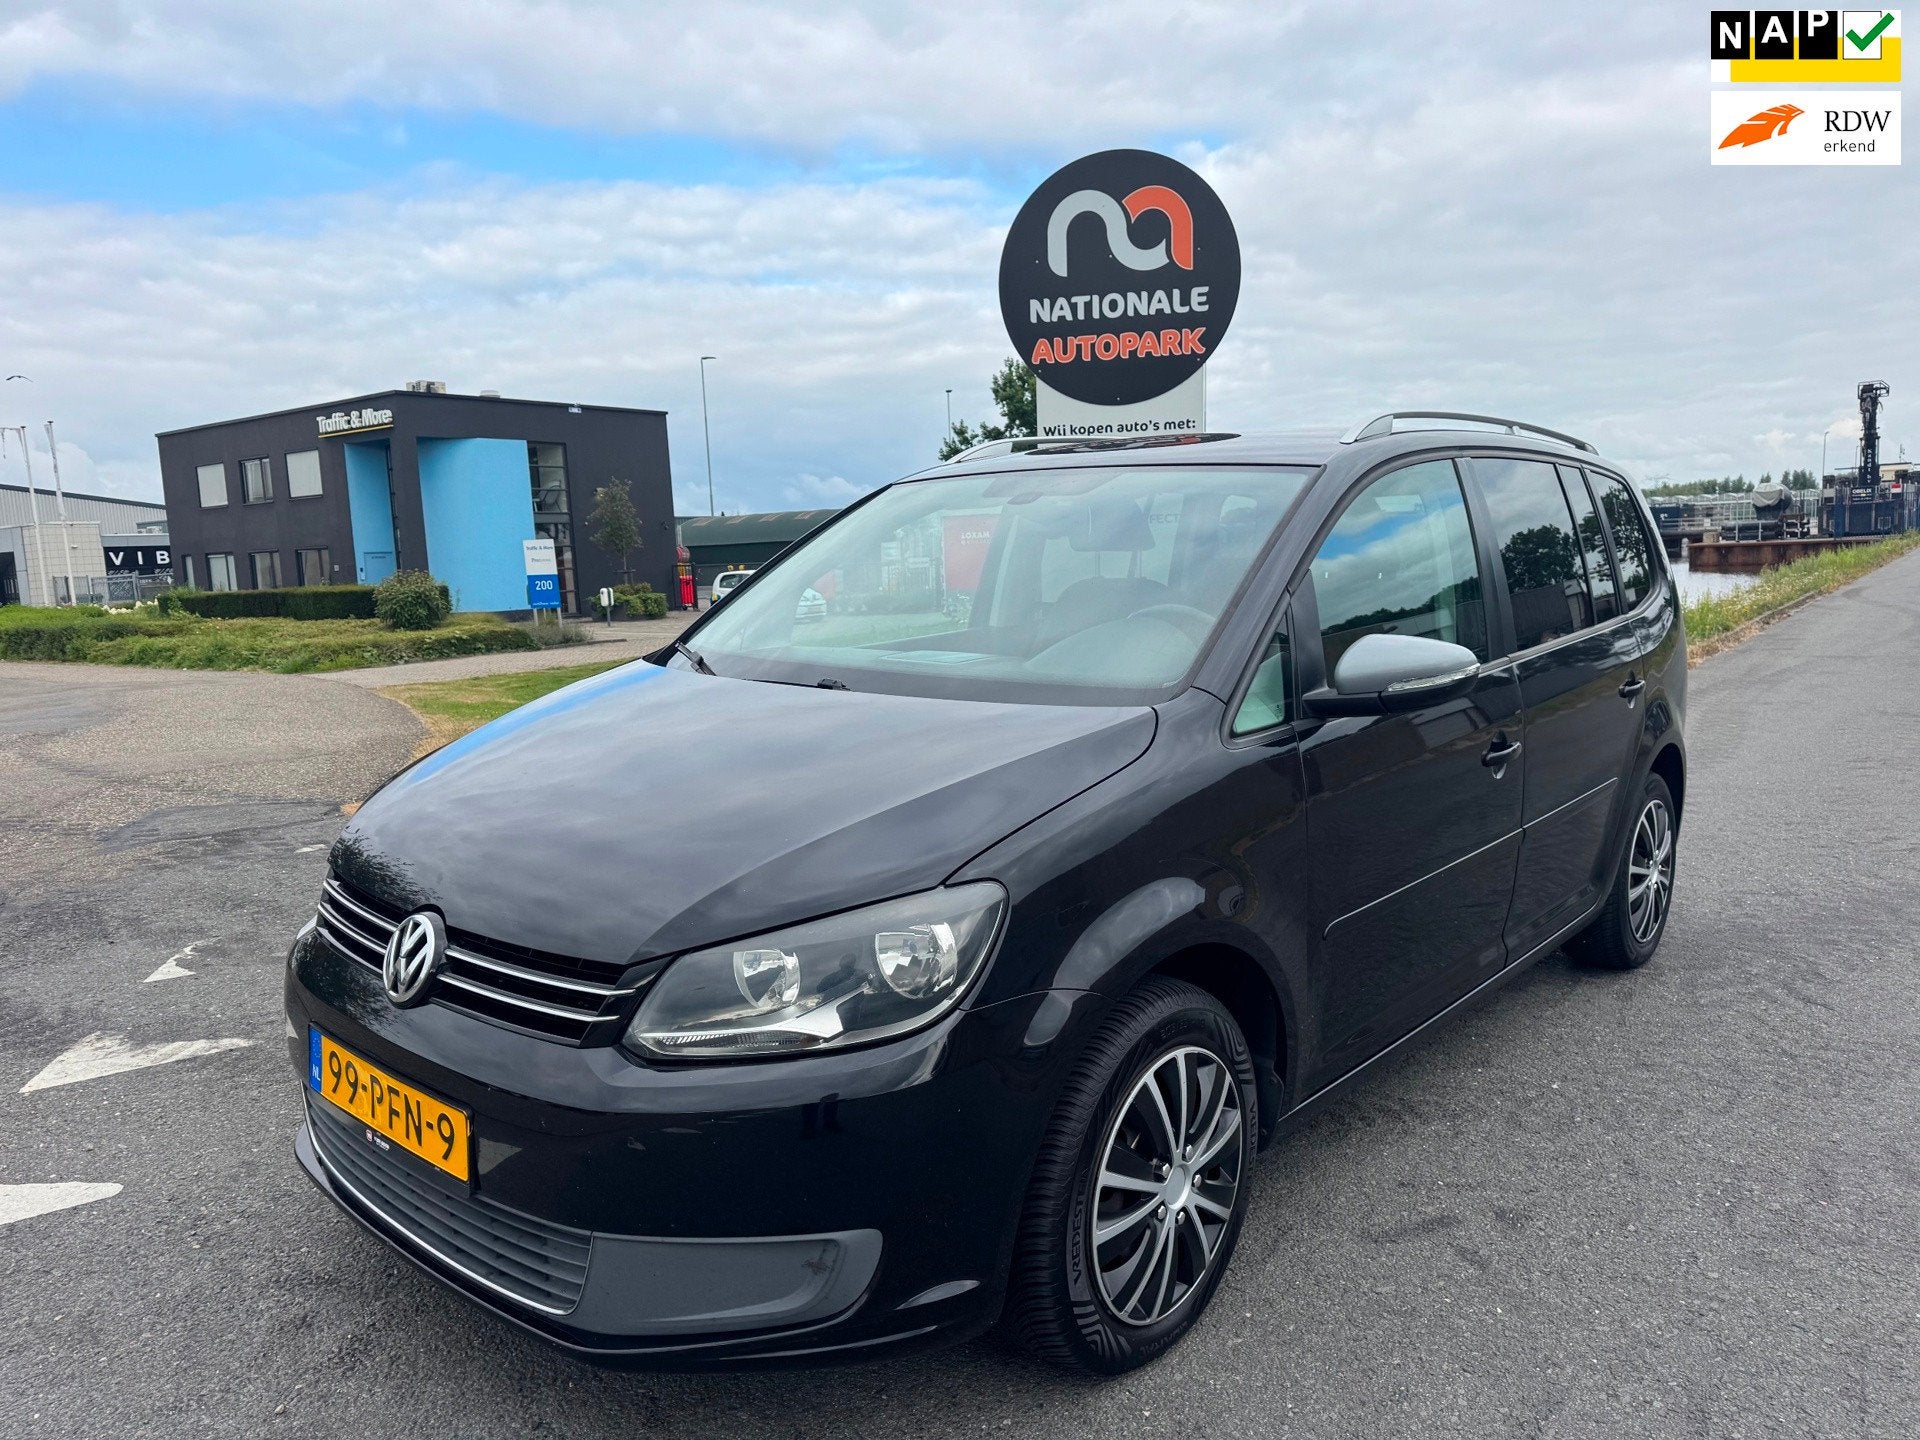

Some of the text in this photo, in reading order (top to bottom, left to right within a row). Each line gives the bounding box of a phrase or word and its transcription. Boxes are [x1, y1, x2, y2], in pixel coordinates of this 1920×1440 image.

[1029, 286, 1210, 324] NATIONALE
[1031, 327, 1207, 365] AUTOPARK
[1043, 418, 1196, 436] Wij kopen auto's met:
[535, 580, 553, 591] 200
[312, 1063, 321, 1081] NL
[328, 1050, 455, 1161] 99-PFN-9
